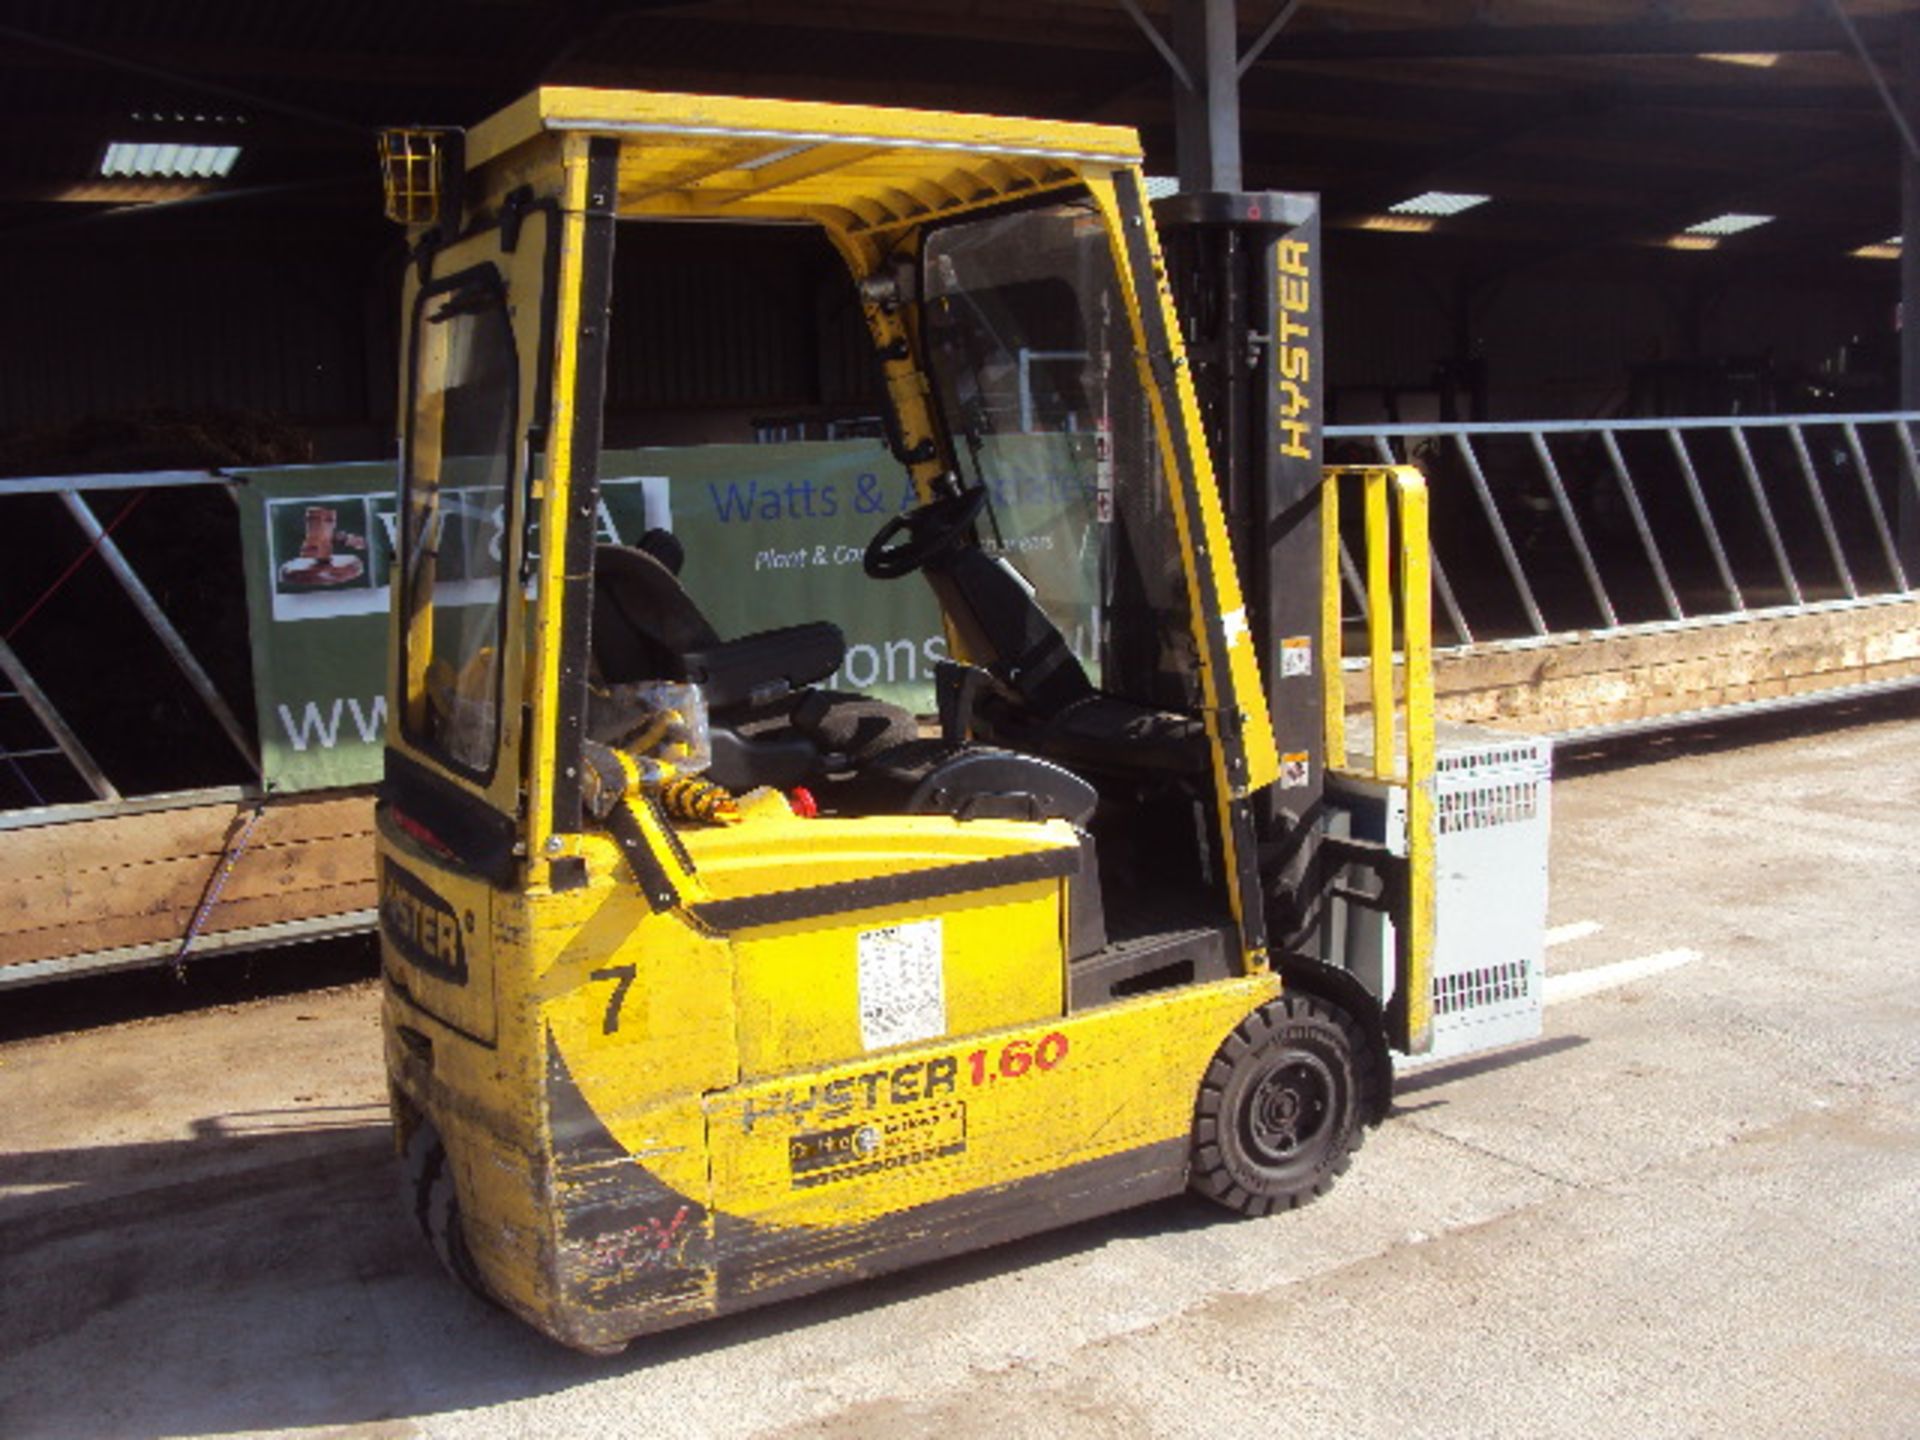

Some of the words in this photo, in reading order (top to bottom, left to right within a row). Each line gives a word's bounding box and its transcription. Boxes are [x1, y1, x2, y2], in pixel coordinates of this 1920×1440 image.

[1276, 238, 1311, 460] HYSTER
[709, 477, 837, 524] Watts
[854, 472, 885, 516] &
[755, 547, 808, 571] Plant
[812, 545, 829, 565] &
[589, 963, 637, 1035] 7
[966, 1031, 1070, 1087] 1.60
